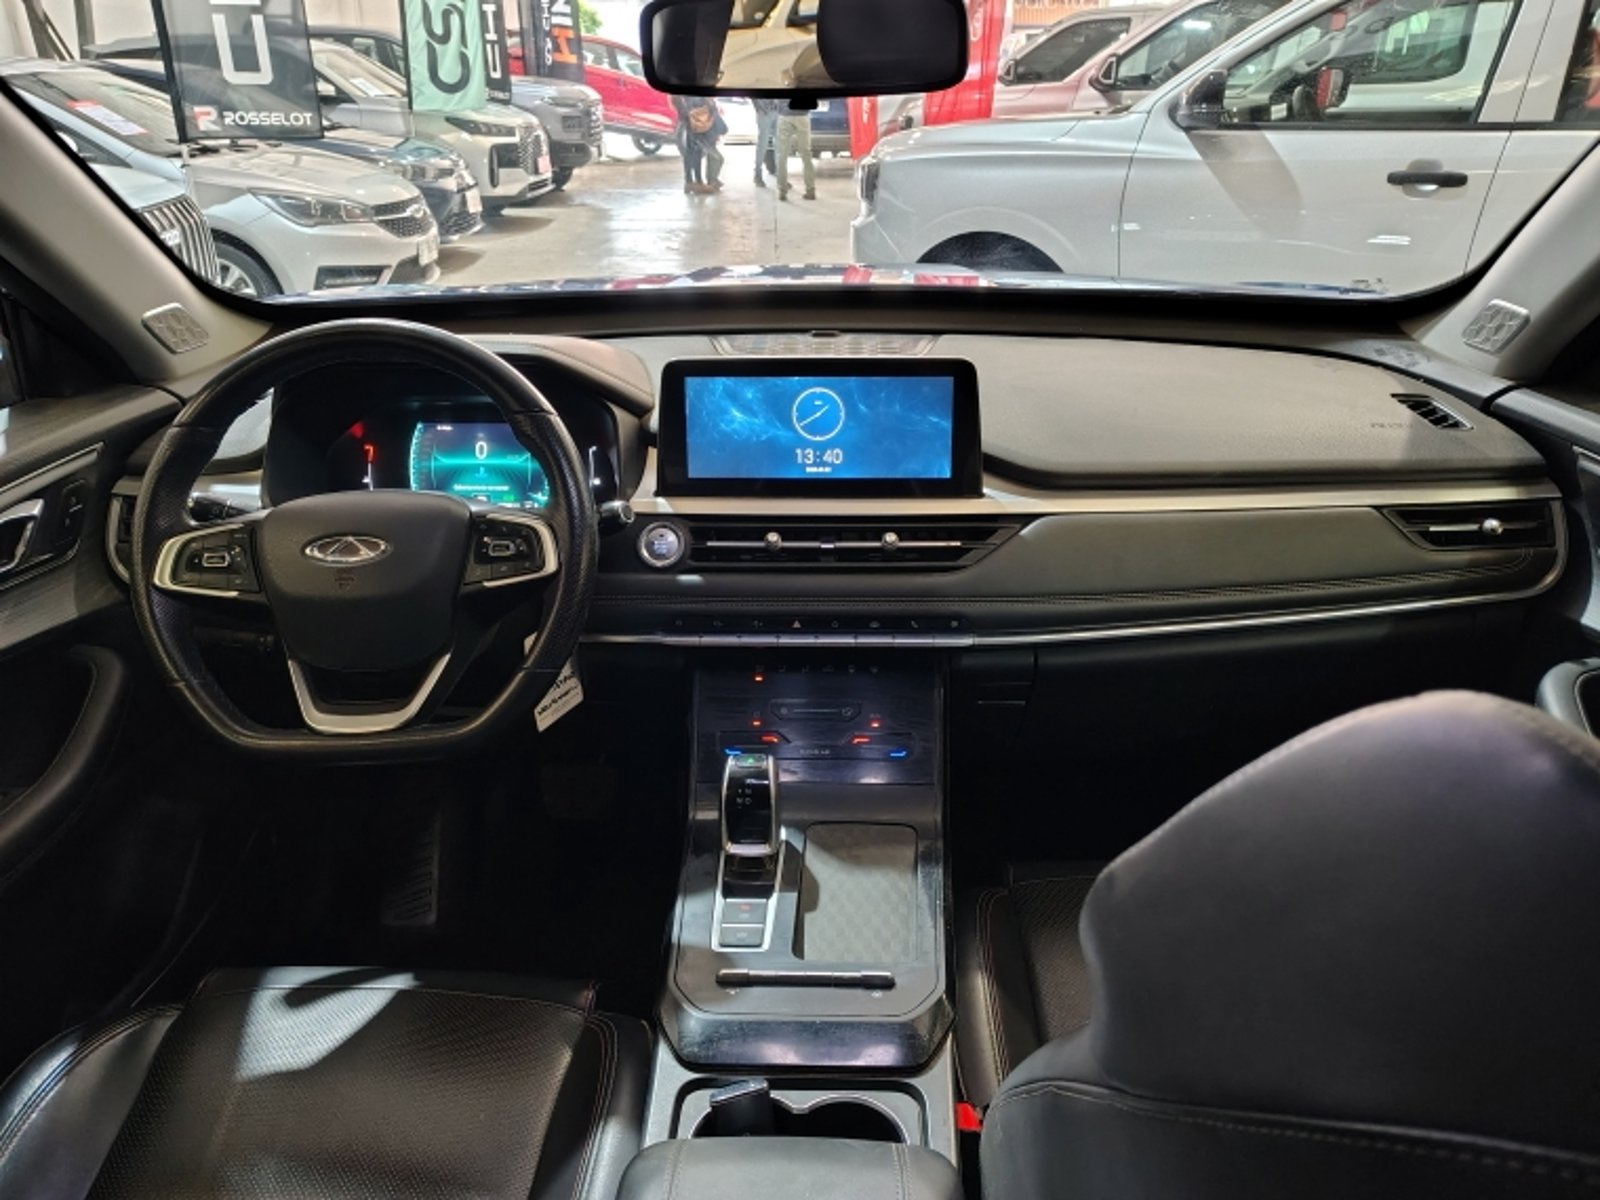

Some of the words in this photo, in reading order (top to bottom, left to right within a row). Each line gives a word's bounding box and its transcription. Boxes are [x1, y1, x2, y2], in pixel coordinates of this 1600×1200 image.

[222, 110, 313, 126] ROSSELOT
[475, 441, 488, 460] 0
[795, 447, 844, 465] 13:40
